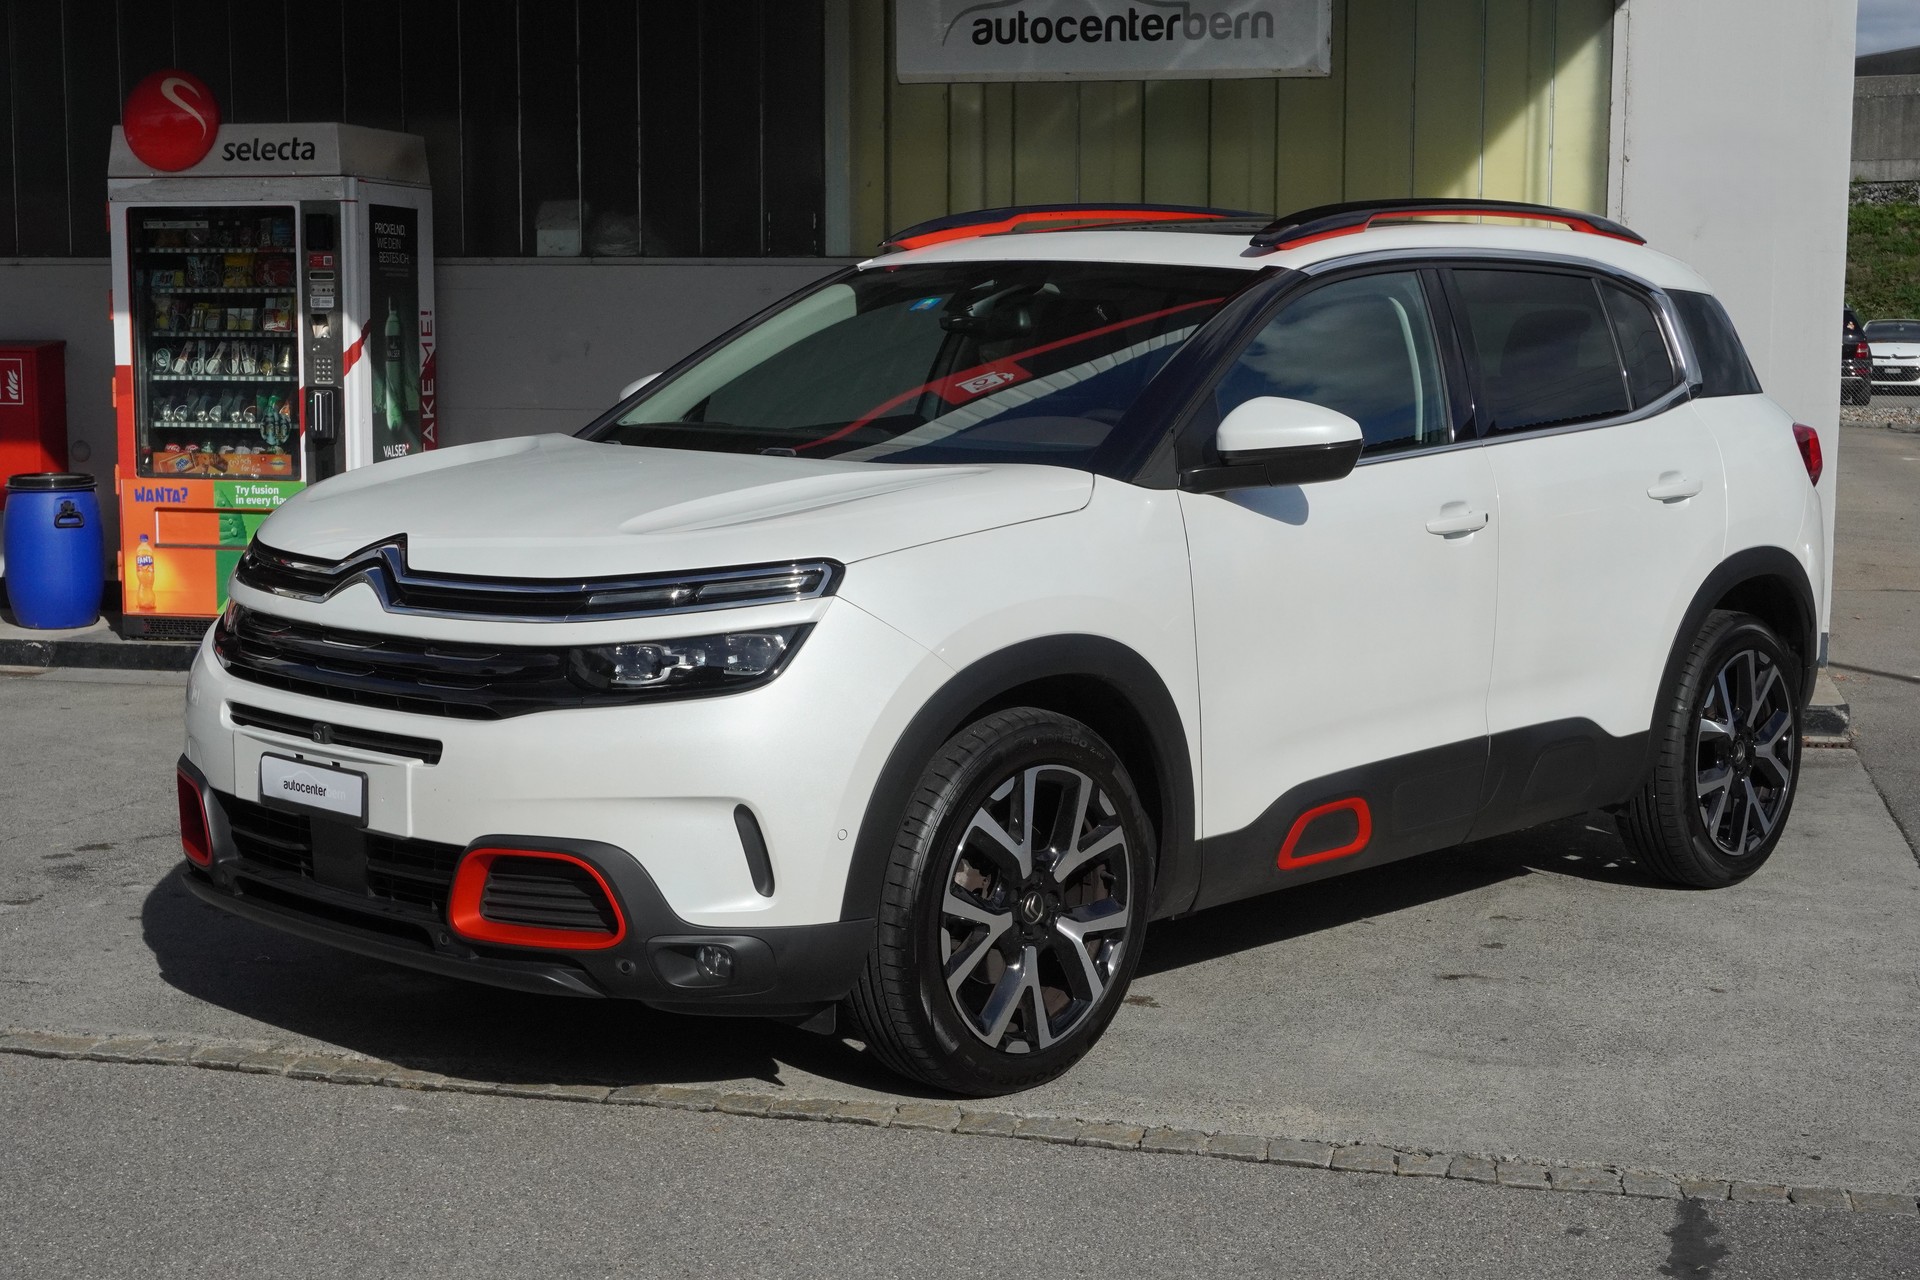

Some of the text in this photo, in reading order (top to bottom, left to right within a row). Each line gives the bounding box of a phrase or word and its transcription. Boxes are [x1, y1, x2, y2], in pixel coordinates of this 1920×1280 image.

[221, 137, 316, 162] selecta
[374, 222, 406, 238] PRICKELND,
[382, 443, 408, 458] VALSER
[134, 486, 188, 504] WANTA?
[235, 484, 279, 497] Try fusion
[235, 495, 245, 505] in
[246, 497, 271, 507] every
